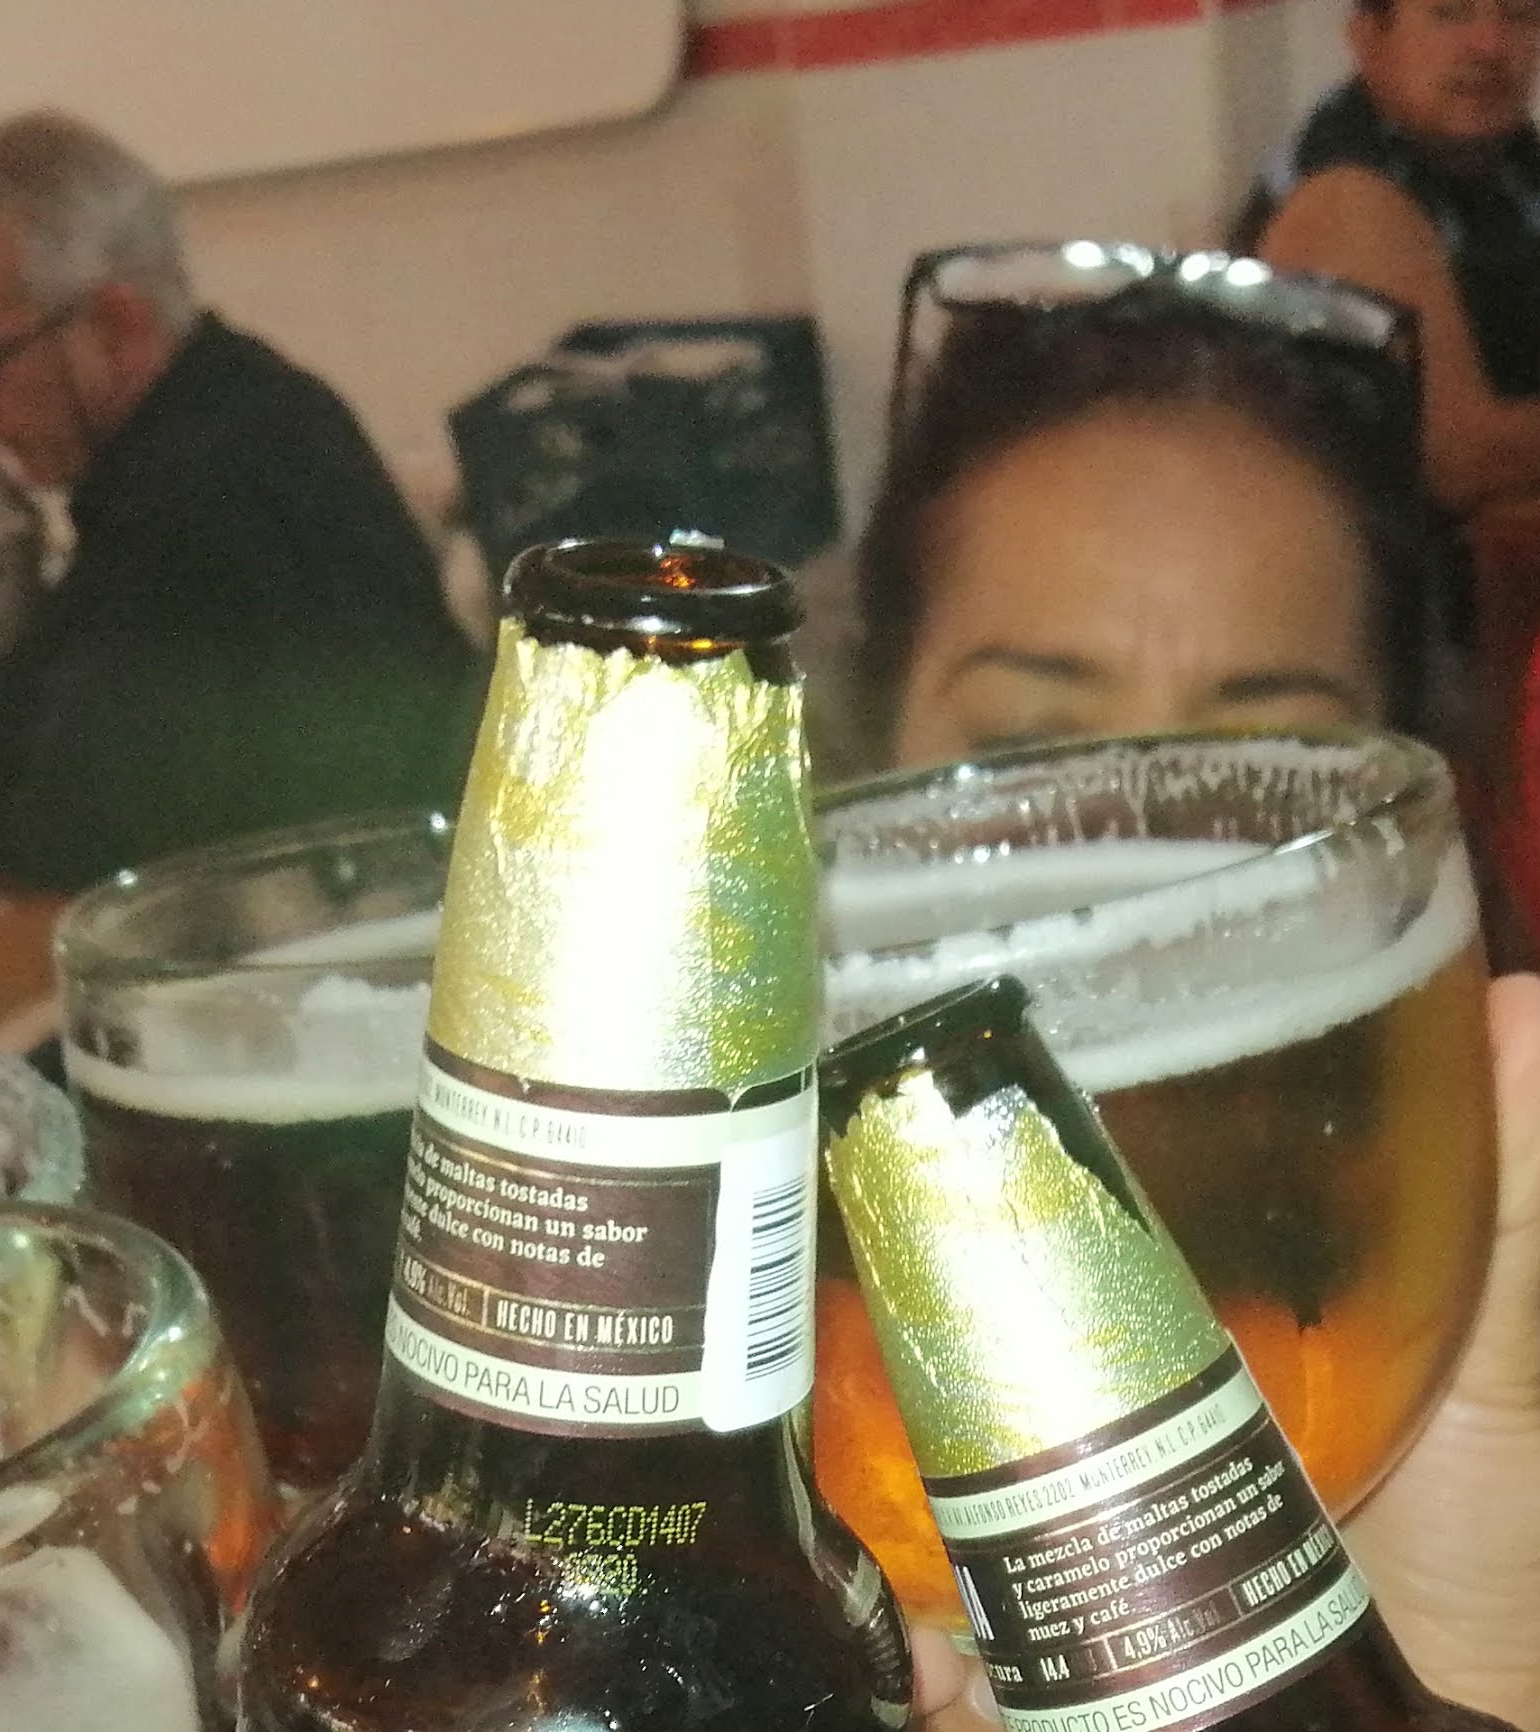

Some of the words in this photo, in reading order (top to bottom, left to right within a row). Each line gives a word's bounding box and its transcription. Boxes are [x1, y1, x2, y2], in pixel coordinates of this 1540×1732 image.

[425, 1177, 539, 1232] proporcionan
[545, 1218, 576, 1238] un
[582, 1219, 648, 1243] sabor
[440, 1157, 496, 1193] maltas
[501, 1177, 589, 1212] tostadas
[429, 1203, 470, 1239] dulce
[472, 1226, 505, 1252] con
[510, 1236, 571, 1264] notas
[576, 1245, 606, 1268] de
[496, 1299, 557, 1339] HECHO
[563, 1312, 590, 1342] EN
[596, 1311, 674, 1346] MÉXICO
[398, 1325, 459, 1383] NOCIVO
[464, 1360, 531, 1407] PARA
[539, 1379, 575, 1412] LA
[583, 1384, 679, 1415] SALUD
[524, 1498, 707, 1547] L276CD1407
[963, 1499, 1007, 1526] ALFONSO
[1006, 1488, 1044, 1519] REYES
[1043, 1477, 1076, 1507] 2202
[1003, 1556, 1026, 1574] La
[1027, 1535, 1094, 1569] mezcla
[1096, 1522, 1122, 1547] de
[1124, 1494, 1190, 1536] maltas
[1190, 1456, 1254, 1504] tostadas
[1012, 1582, 1024, 1601] y
[1026, 1555, 1111, 1595] caramelo
[1114, 1497, 1238, 1570] proporcionan
[1235, 1483, 1260, 1505] un
[1257, 1459, 1286, 1490] sabor
[1018, 1575, 1132, 1621] ligeramente
[1134, 1549, 1188, 1584] dulce
[1190, 1533, 1224, 1559] con
[1223, 1505, 1268, 1543] notas
[1266, 1492, 1285, 1514] de
[1027, 1621, 1071, 1643] nuez
[1072, 1617, 1086, 1636] y
[1123, 1624, 1167, 1661] 4,9%
[1241, 1560, 1292, 1608] HECHO
[1287, 1548, 1309, 1578] EN
[1112, 1700, 1147, 1732] ES
[1148, 1661, 1244, 1721] NOCIVO
[1244, 1627, 1310, 1679] PARA
[1303, 1611, 1334, 1644] LA
